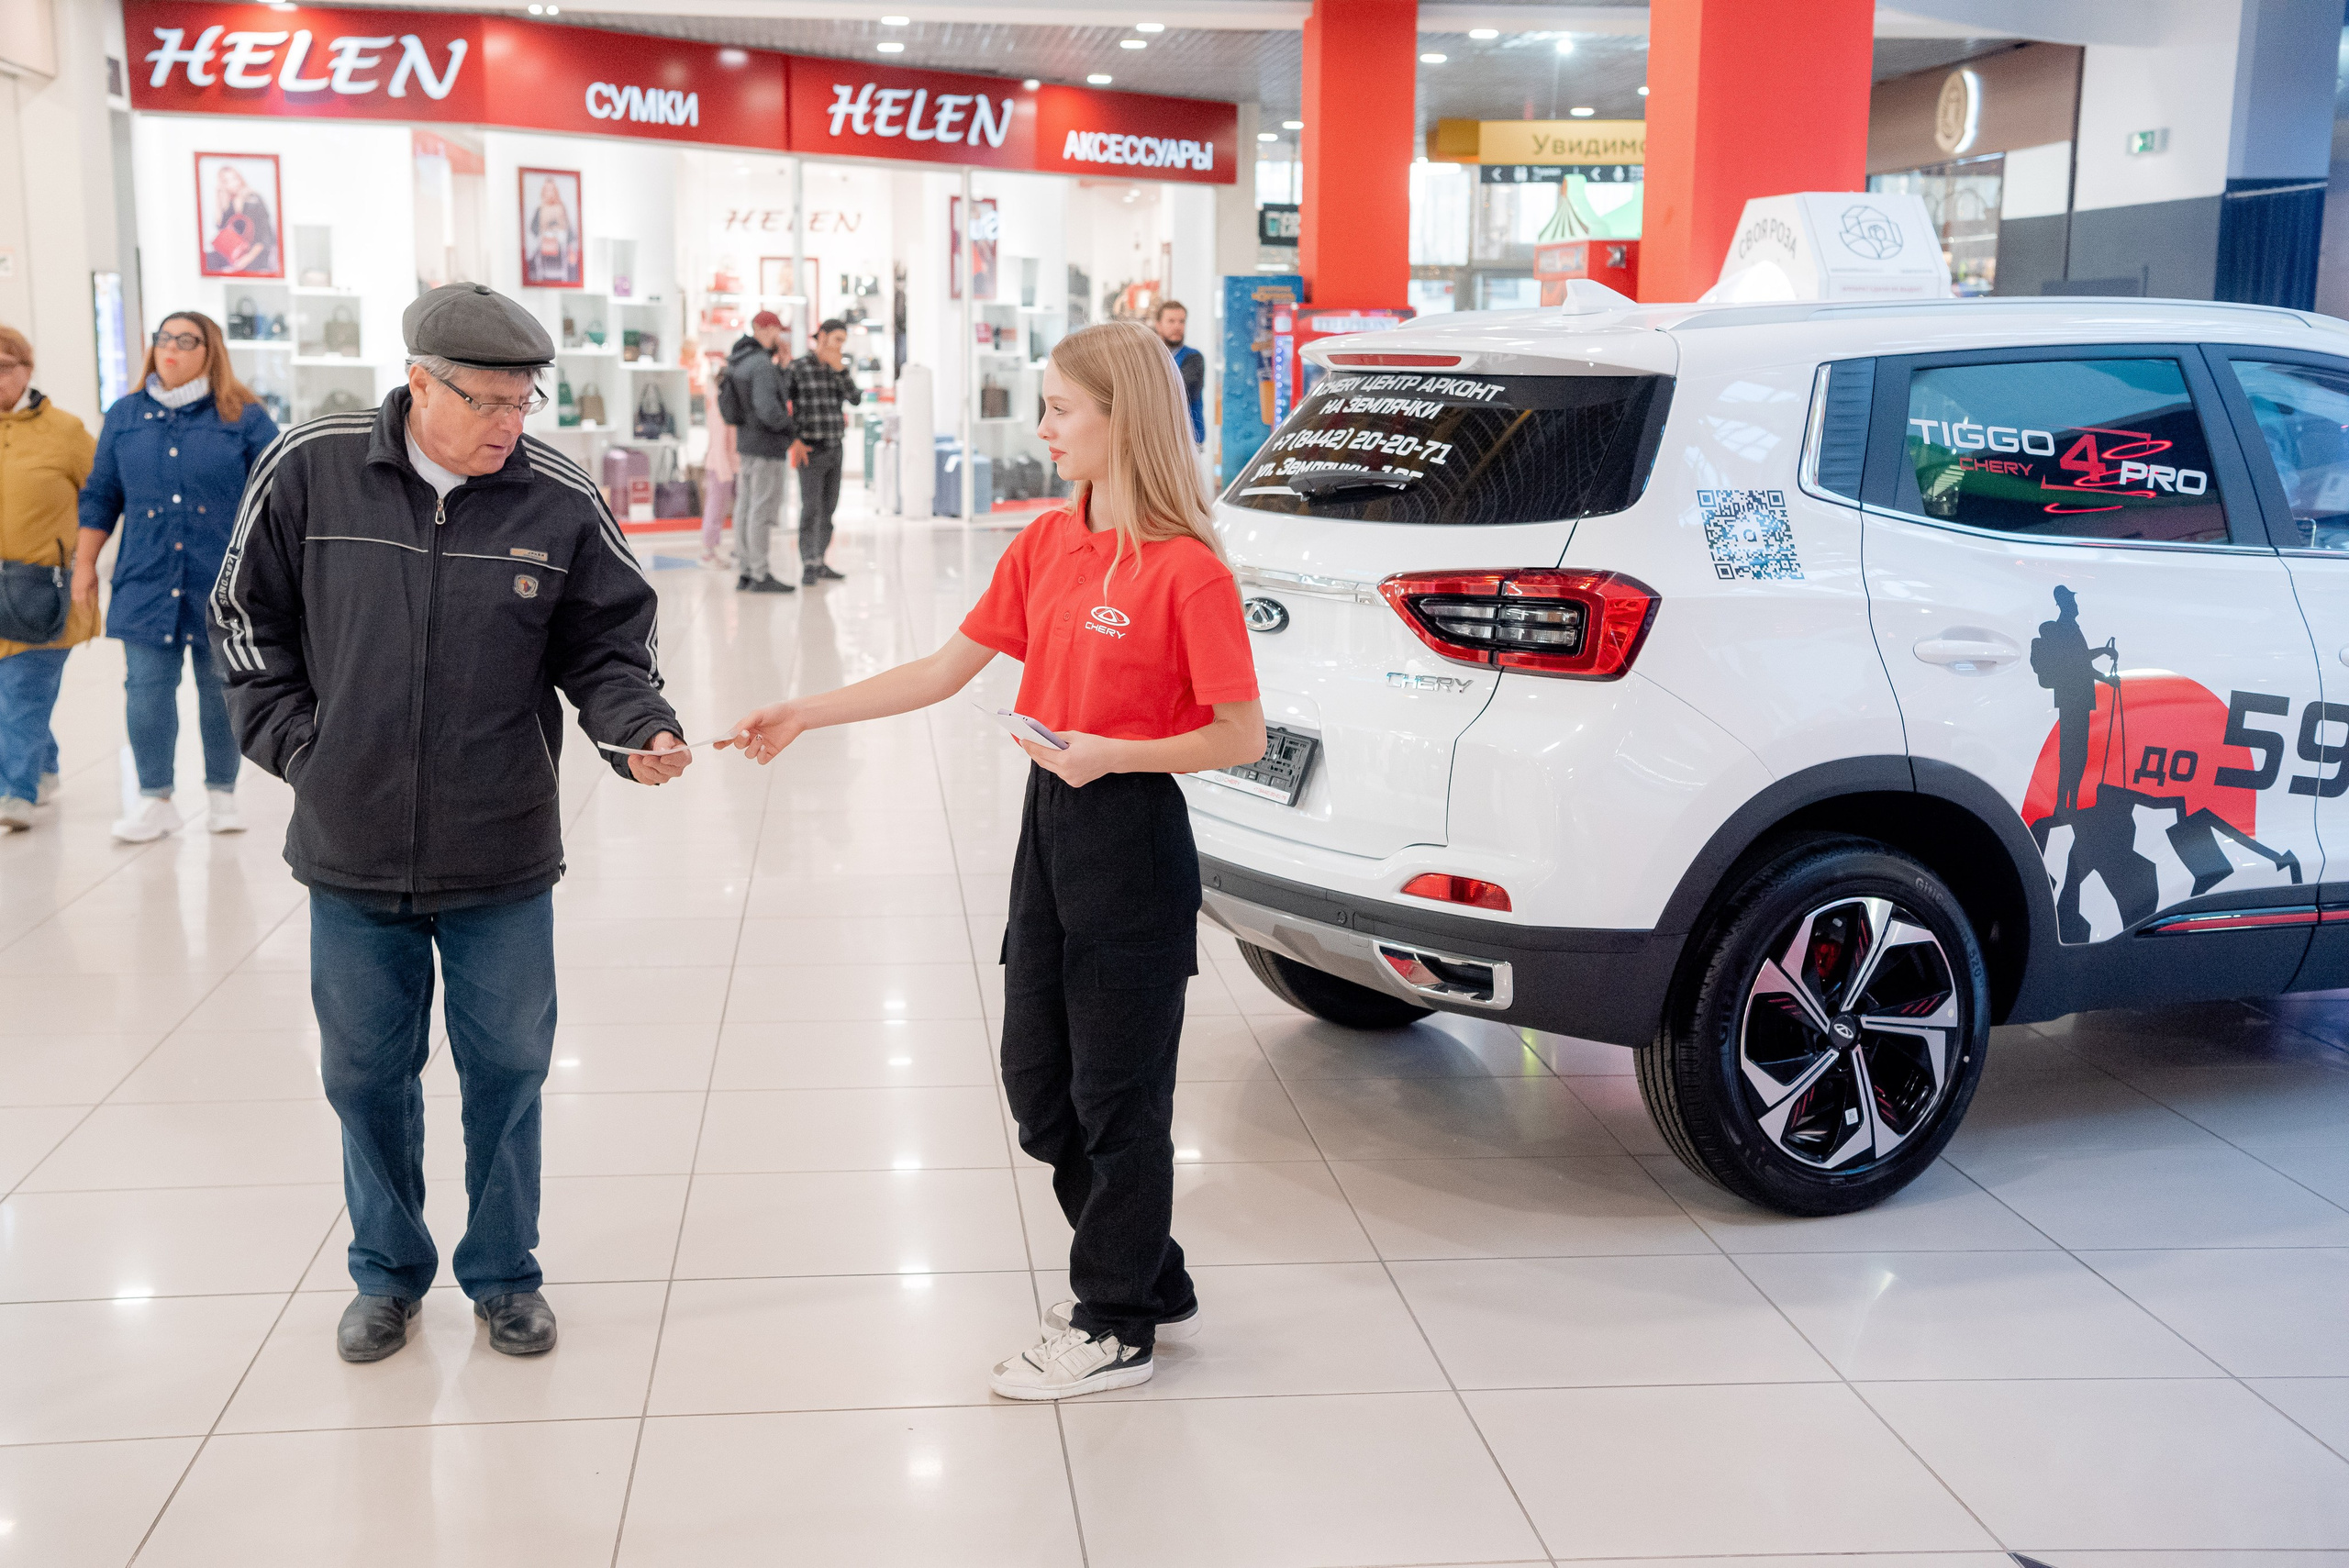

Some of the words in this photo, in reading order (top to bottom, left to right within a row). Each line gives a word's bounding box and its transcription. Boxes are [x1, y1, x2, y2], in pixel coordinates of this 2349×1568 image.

[145, 25, 469, 100] HELEN
[585, 82, 699, 127] СУМКИ
[828, 83, 1014, 148] HELEN
[1063, 129, 1214, 171] АКСЕССУАРЫ
[1739, 218, 1769, 260] СВОЯ
[1770, 217, 1798, 260] РОЗА
[1319, 376, 1364, 396] CHERY
[1361, 374, 1423, 392] ЦЕНТР
[1417, 376, 1506, 402] АРКОНТ
[1319, 399, 1342, 415] НА
[1341, 395, 1445, 420] ЗЕМЛЯЧКИ
[1272, 431, 1291, 451] +7
[1287, 428, 1354, 450] (8442)
[1348, 431, 1453, 465] 20-20-71
[1909, 418, 2055, 457] TIGGO
[2060, 433, 2106, 482] 4
[2119, 461, 2208, 495] PRO
[1959, 458, 2033, 477] CHERY
[1085, 621, 1126, 639] CHERY
[1386, 672, 1474, 693] CHERY
